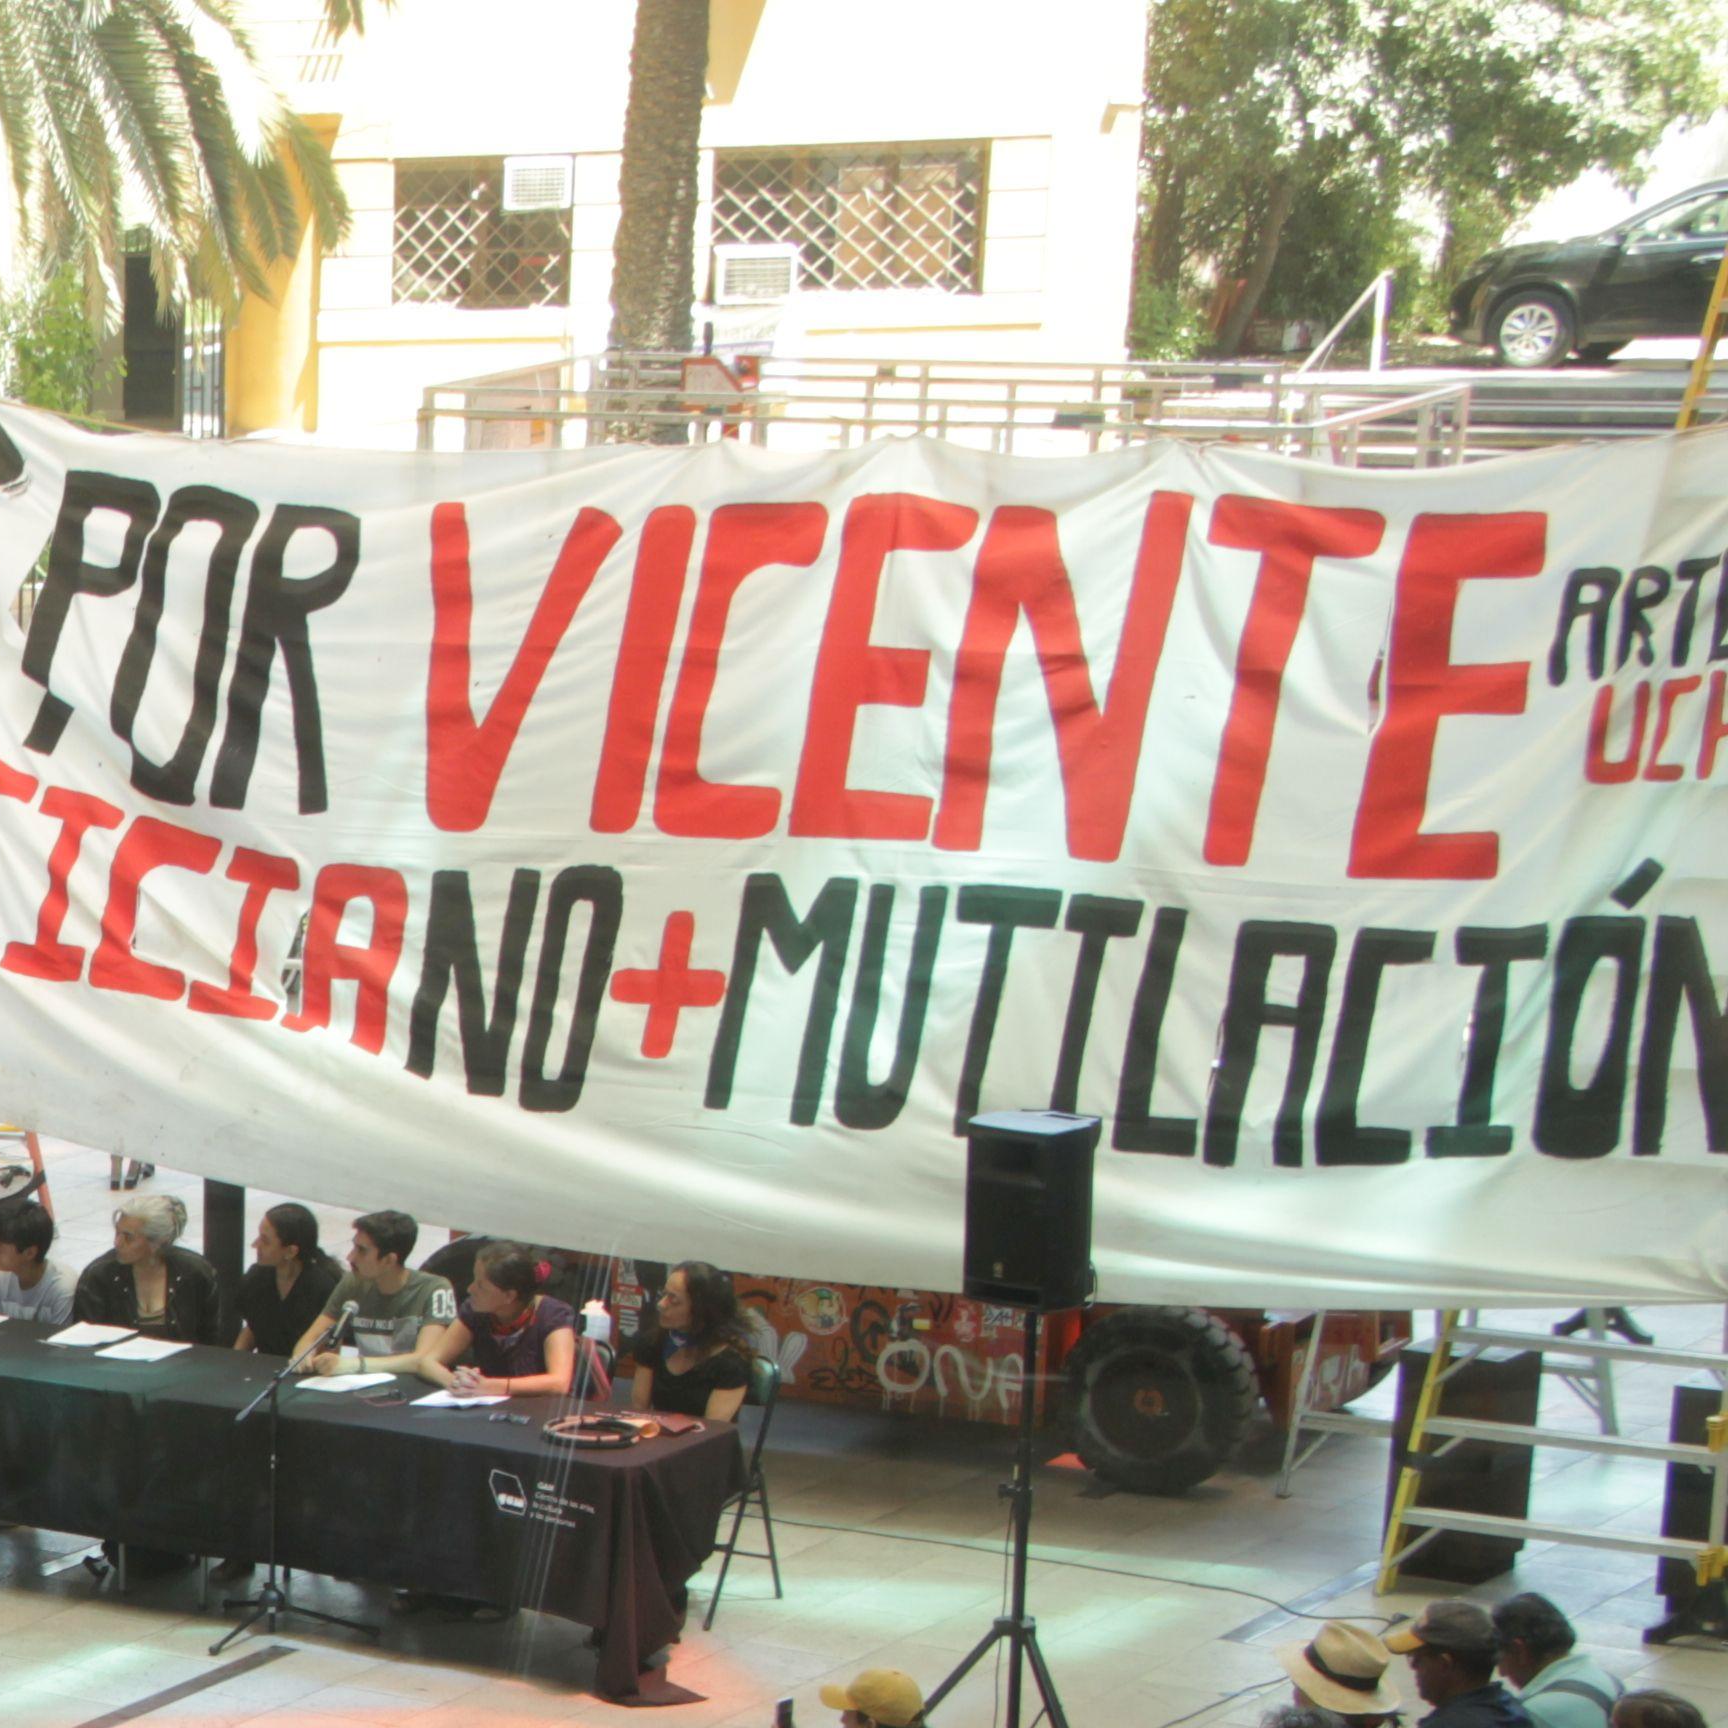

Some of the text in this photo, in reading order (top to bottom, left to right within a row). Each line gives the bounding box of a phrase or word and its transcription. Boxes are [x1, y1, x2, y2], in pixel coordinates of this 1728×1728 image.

[23, 470, 1548, 880] POR VICENTE
[407, 865, 623, 1112] NO
[704, 858, 1728, 1169] MUTILACIÓN
